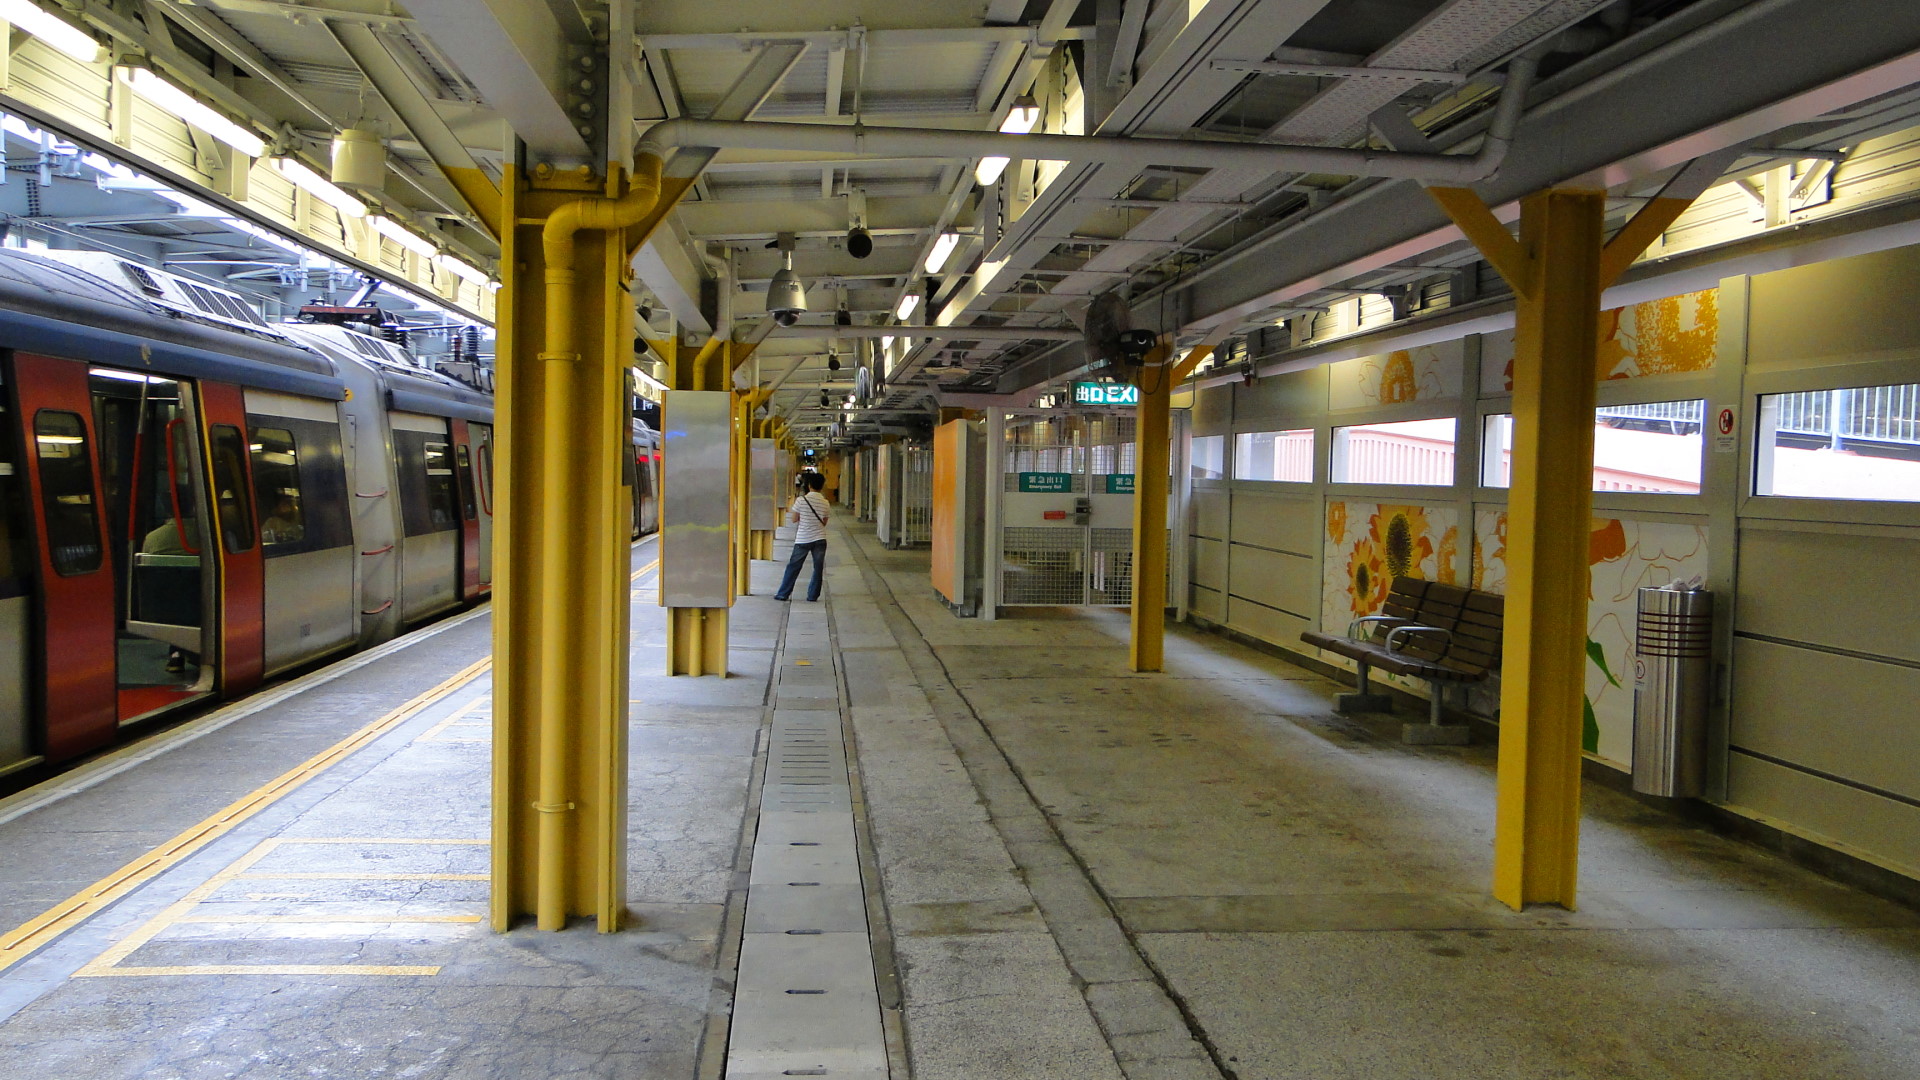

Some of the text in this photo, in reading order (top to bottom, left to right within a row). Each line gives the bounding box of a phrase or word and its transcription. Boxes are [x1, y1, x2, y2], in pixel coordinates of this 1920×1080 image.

[1076, 386, 1138, 402] 出口 EXI
[1116, 477, 1135, 485] 緊急
